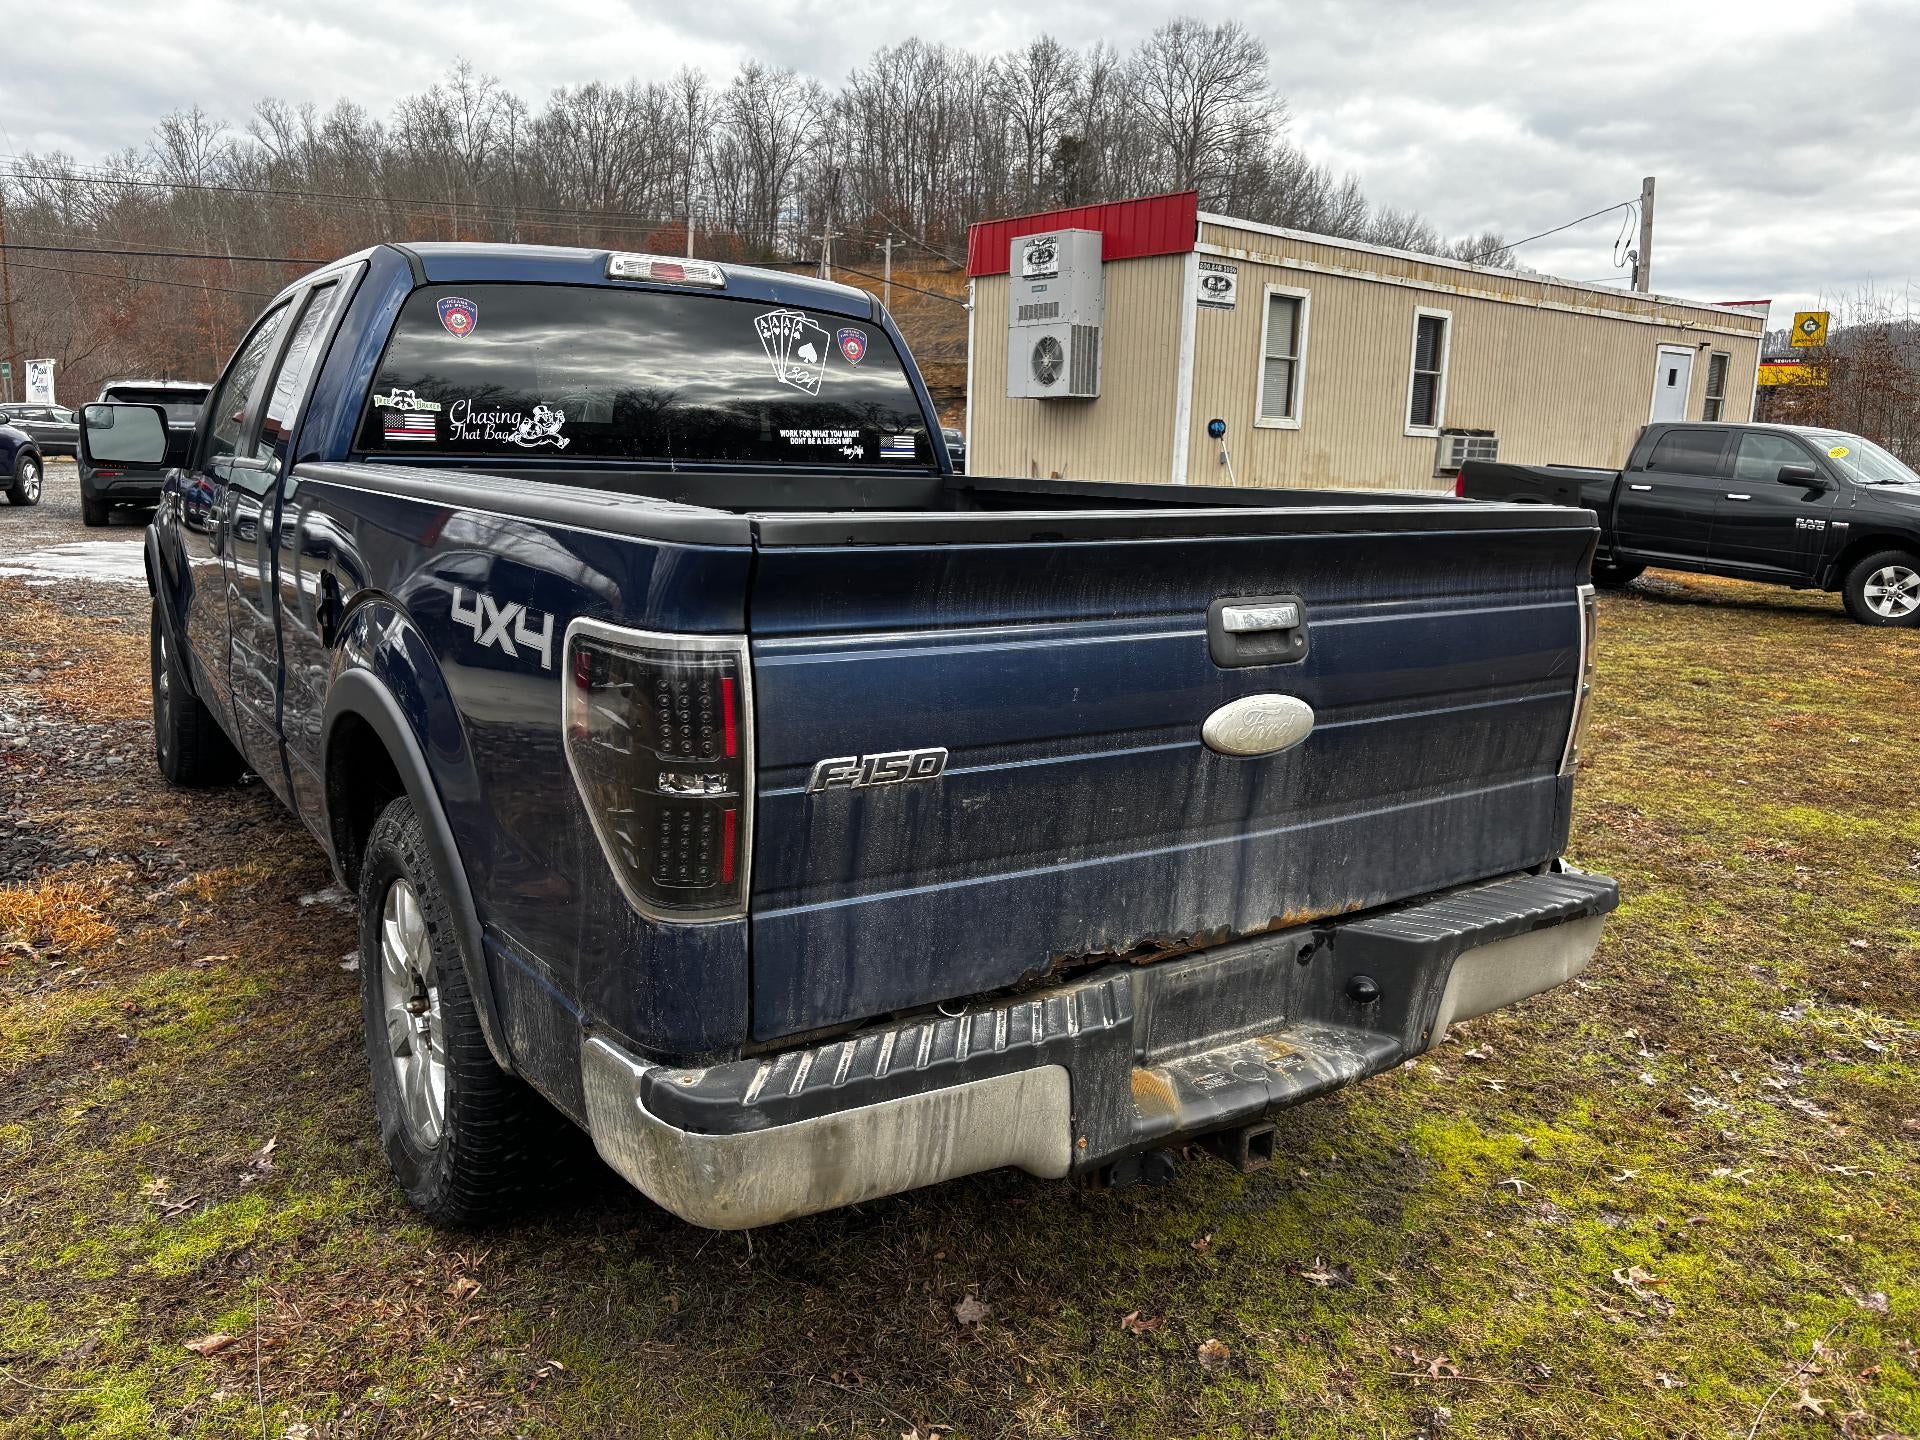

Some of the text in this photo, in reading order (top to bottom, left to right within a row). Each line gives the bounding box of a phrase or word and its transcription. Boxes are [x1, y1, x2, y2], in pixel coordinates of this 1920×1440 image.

[760, 319, 768, 329] A
[772, 316, 779, 326] A
[784, 317, 791, 327] A
[1803, 320, 1816, 332] G
[795, 322, 803, 332] A
[450, 399, 521, 430] Chasing
[450, 424, 510, 443] That Bag
[780, 430, 859, 438] WORK FOR WHAT YOU WANT
[1796, 518, 1826, 526] RAM
[1796, 523, 1825, 531] 1500
[451, 587, 555, 670] 4X4
[1236, 708, 1296, 740] Ford
[806, 747, 949, 794] F-150
